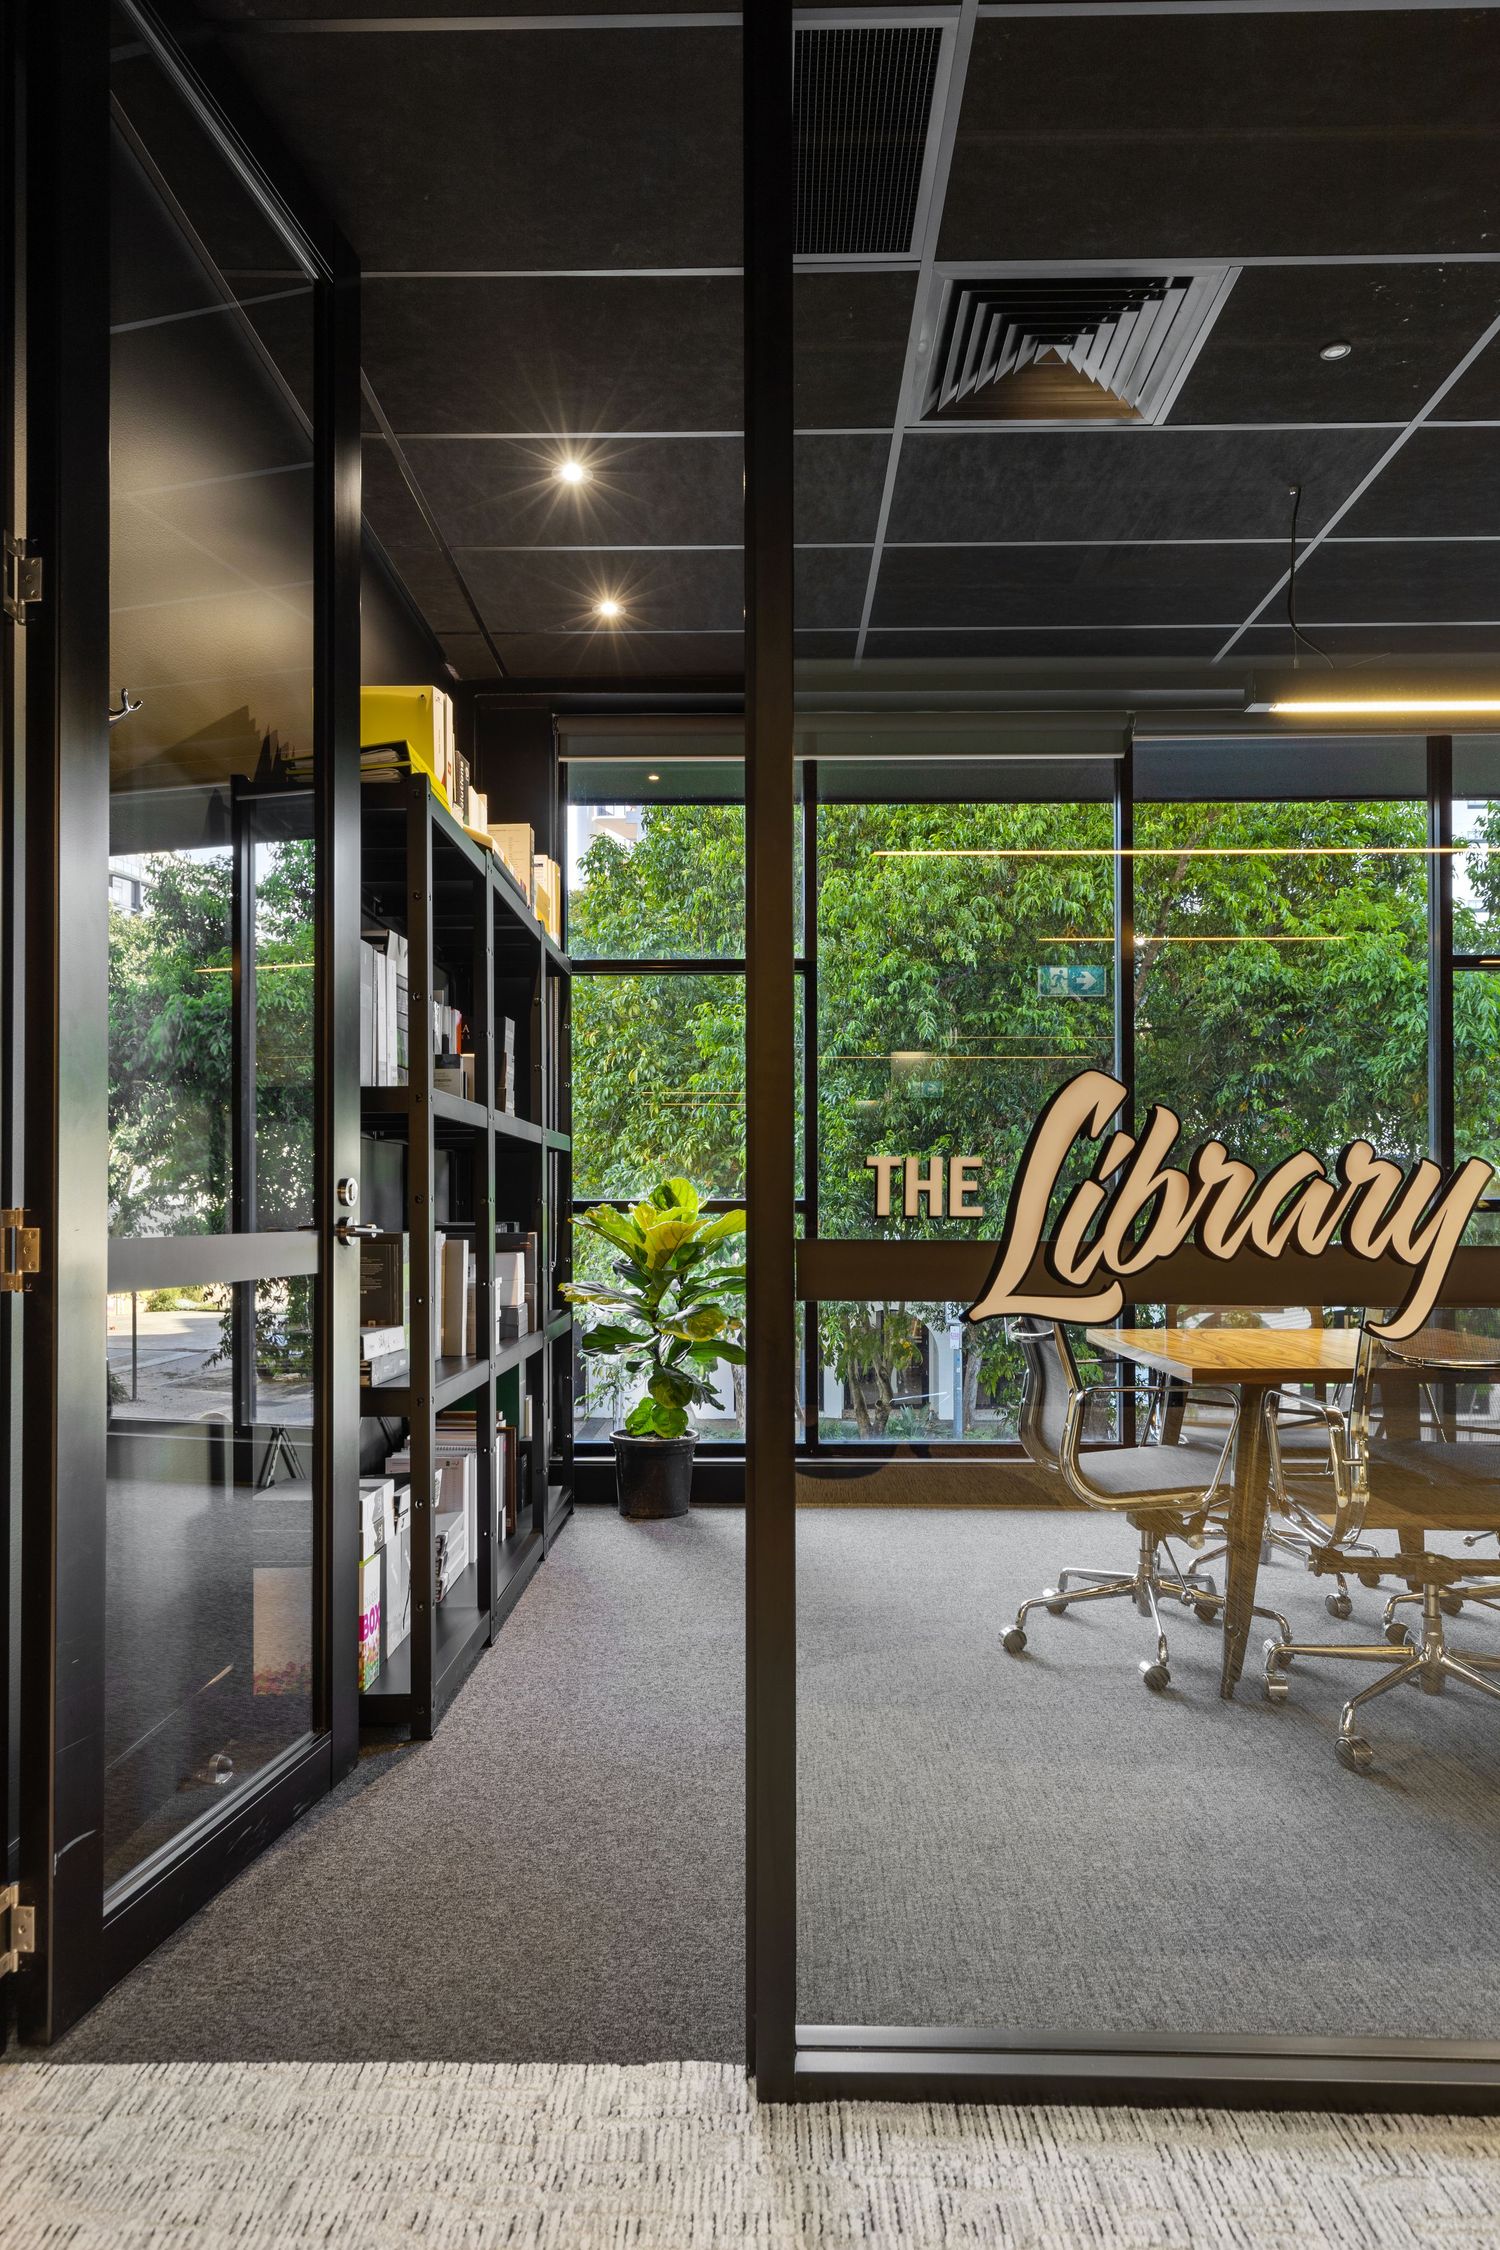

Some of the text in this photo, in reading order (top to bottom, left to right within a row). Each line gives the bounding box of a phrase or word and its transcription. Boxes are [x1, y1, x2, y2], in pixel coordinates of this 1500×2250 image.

[865, 1069, 1494, 1341] THE Library
[362, 1600, 380, 1642] BOX
